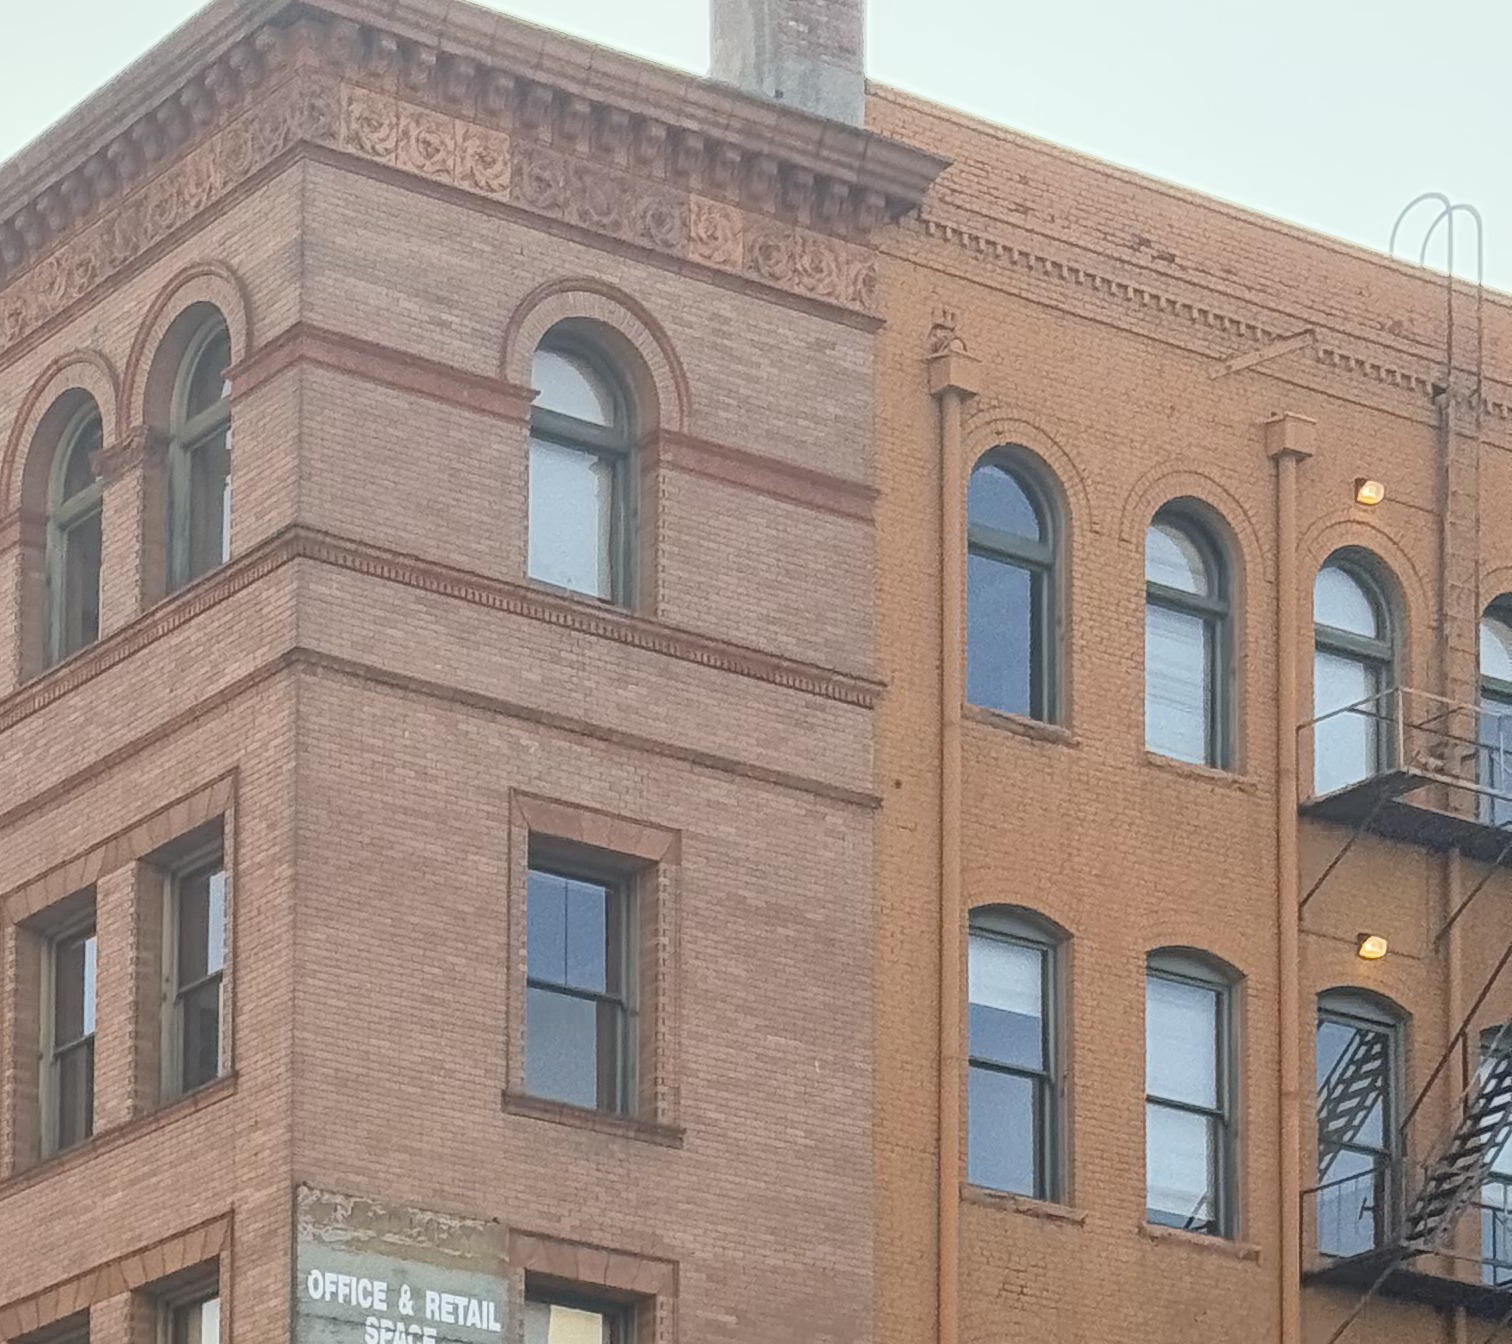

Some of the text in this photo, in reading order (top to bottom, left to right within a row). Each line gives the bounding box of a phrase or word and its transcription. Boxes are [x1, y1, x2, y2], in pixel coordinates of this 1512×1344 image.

[307, 1269, 502, 1333] OFFICE & RETAIL
